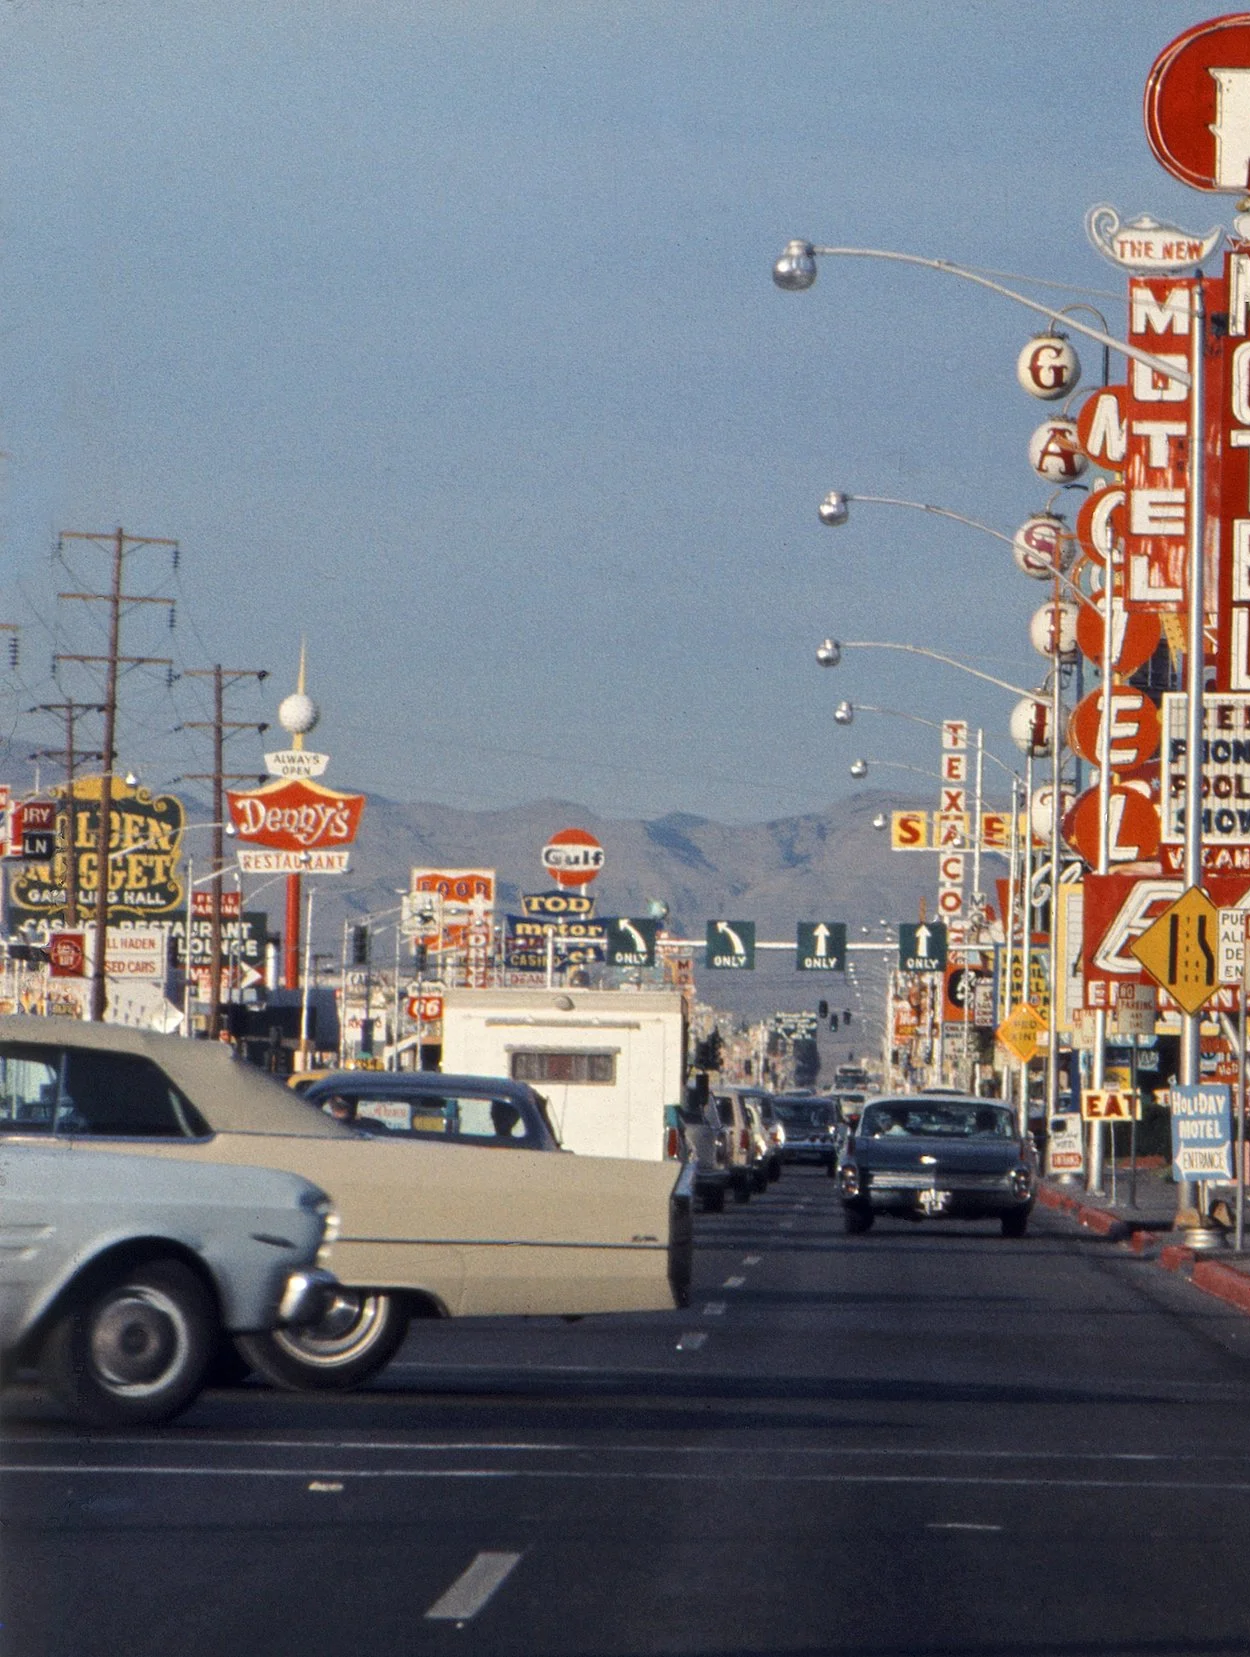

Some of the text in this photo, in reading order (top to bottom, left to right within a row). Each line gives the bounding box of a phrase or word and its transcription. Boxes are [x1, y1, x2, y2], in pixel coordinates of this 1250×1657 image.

[1117, 239, 1202, 260] THE NEW
[1131, 286, 1192, 602] MOTEL
[274, 754, 320, 764] ALWAYS
[282, 766, 310, 776] OPEN
[235, 798, 351, 845] Denny's
[939, 723, 966, 912] TEXACO
[242, 855, 346, 869] RESTAURANT
[544, 850, 604, 867] Gulf
[124, 891, 166, 905] HALL
[529, 897, 591, 912] TOD
[515, 920, 603, 936] motor
[615, 952, 648, 964] ONLY
[713, 956, 747, 967] ONLY
[804, 957, 838, 969] ONLY
[906, 958, 940, 970] ONLY
[1179, 1119, 1223, 1139] MOTEL
[1182, 1150, 1225, 1170] ENTRANCE
